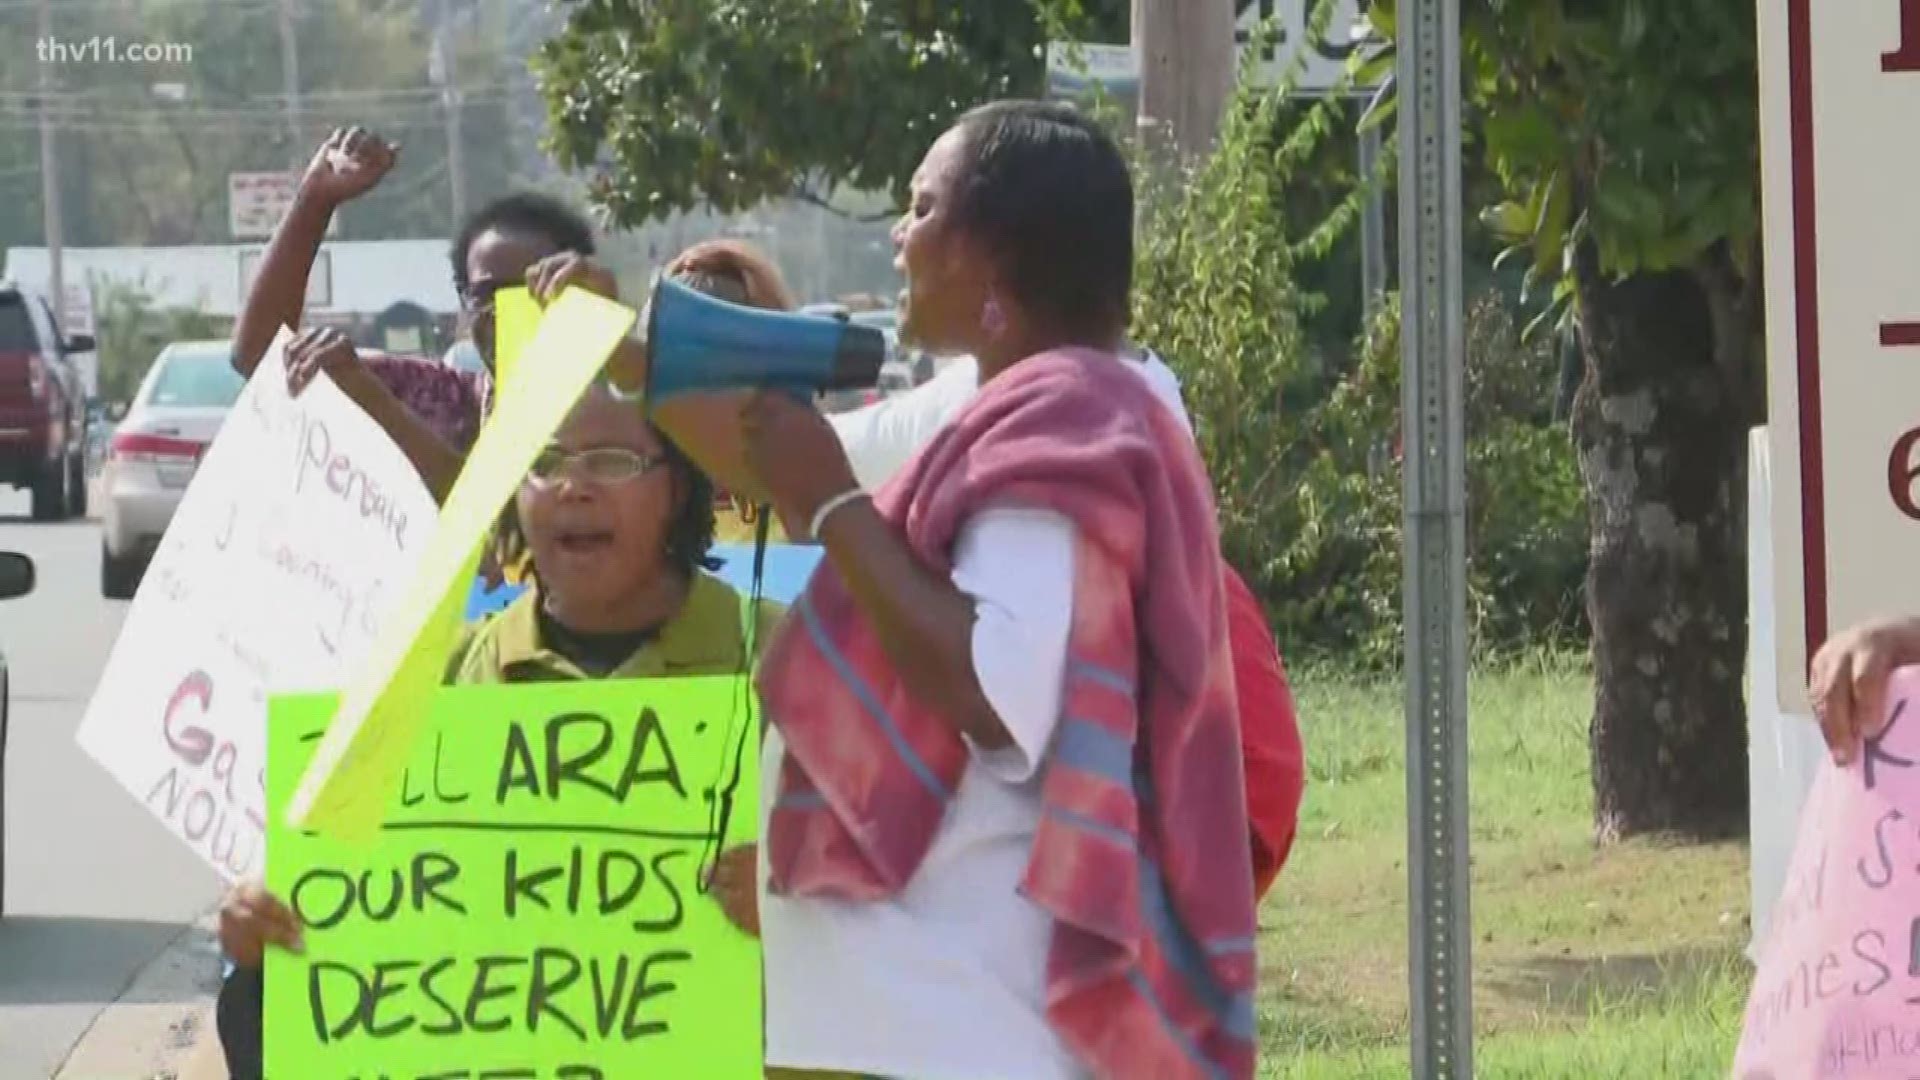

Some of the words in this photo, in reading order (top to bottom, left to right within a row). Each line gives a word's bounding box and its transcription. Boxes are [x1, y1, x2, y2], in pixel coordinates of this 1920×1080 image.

[291, 851, 467, 930] OUR
[505, 846, 689, 932] KIDS
[308, 947, 692, 1045] DESERVE
